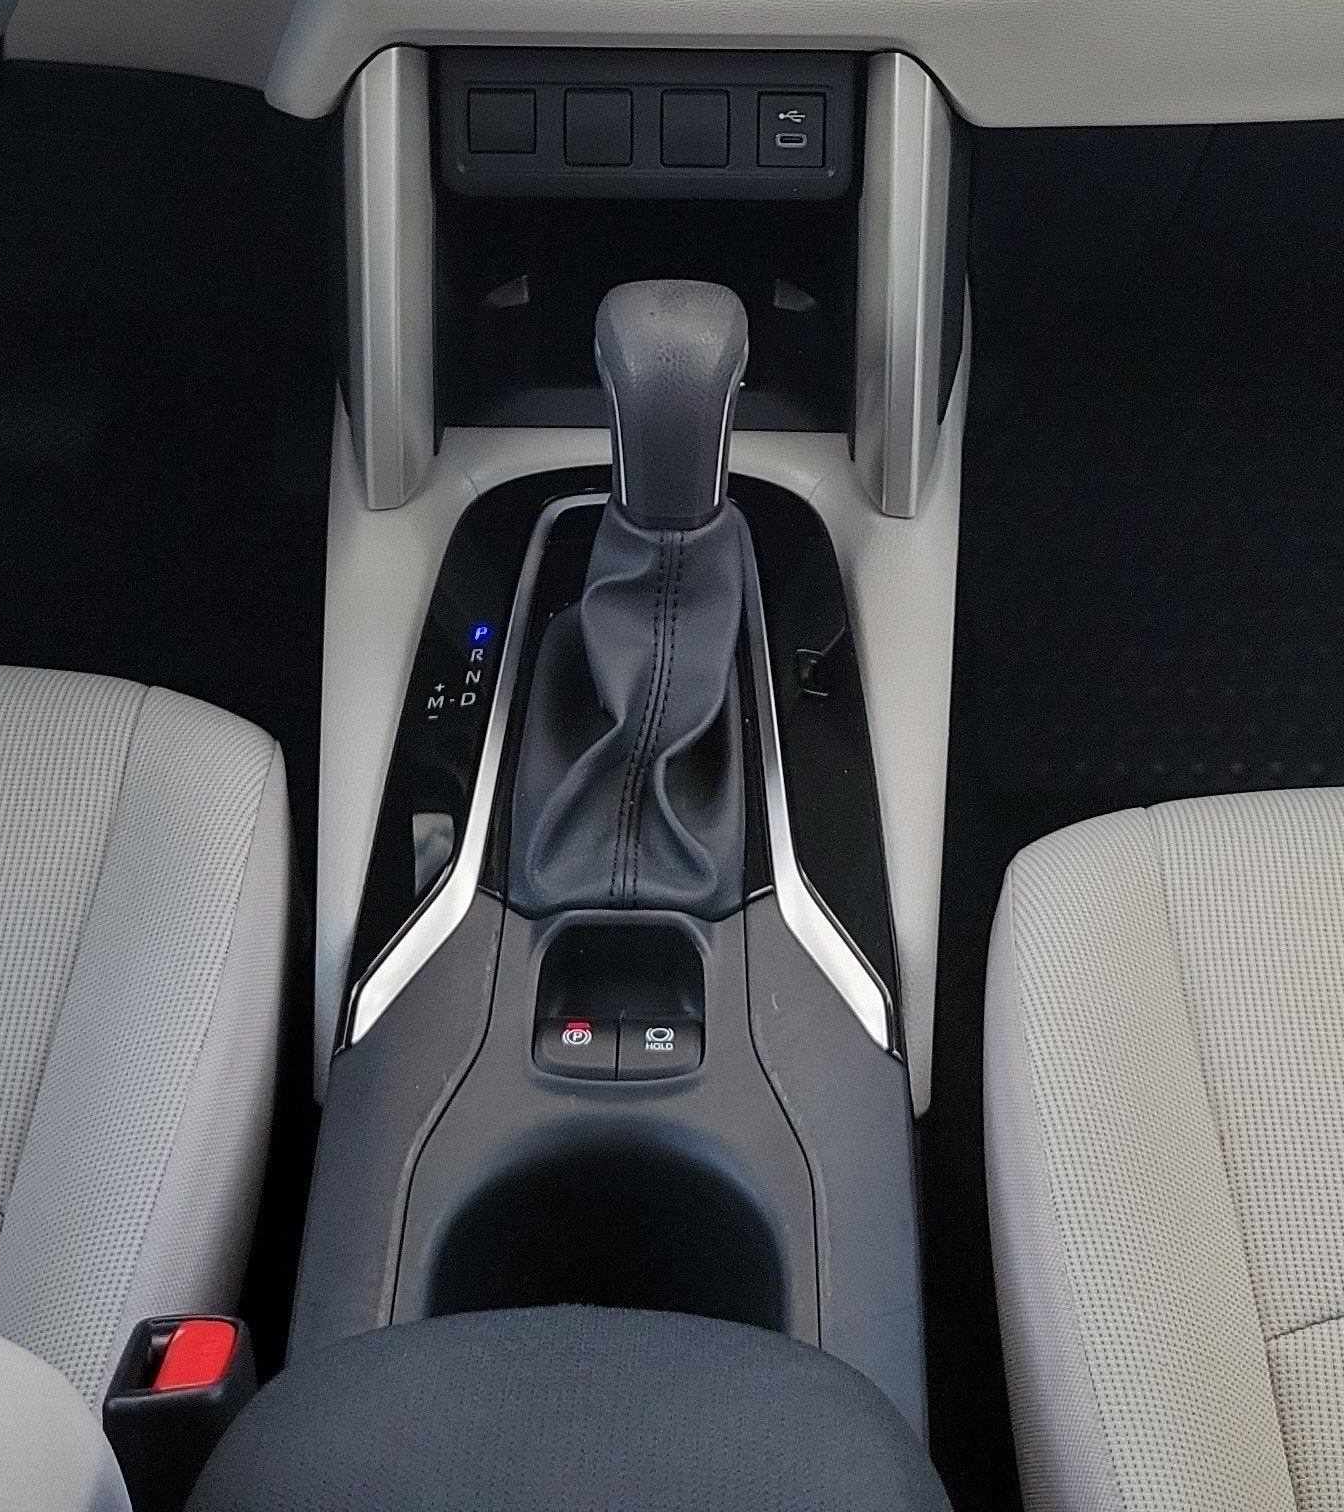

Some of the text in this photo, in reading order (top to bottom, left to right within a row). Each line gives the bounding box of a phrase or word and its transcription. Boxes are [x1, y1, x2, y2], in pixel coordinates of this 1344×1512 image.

[474, 626, 488, 640] P
[470, 648, 484, 662] R
[465, 669, 481, 685] N
[427, 692, 476, 710] M D
[645, 1042, 674, 1051] HOLD
